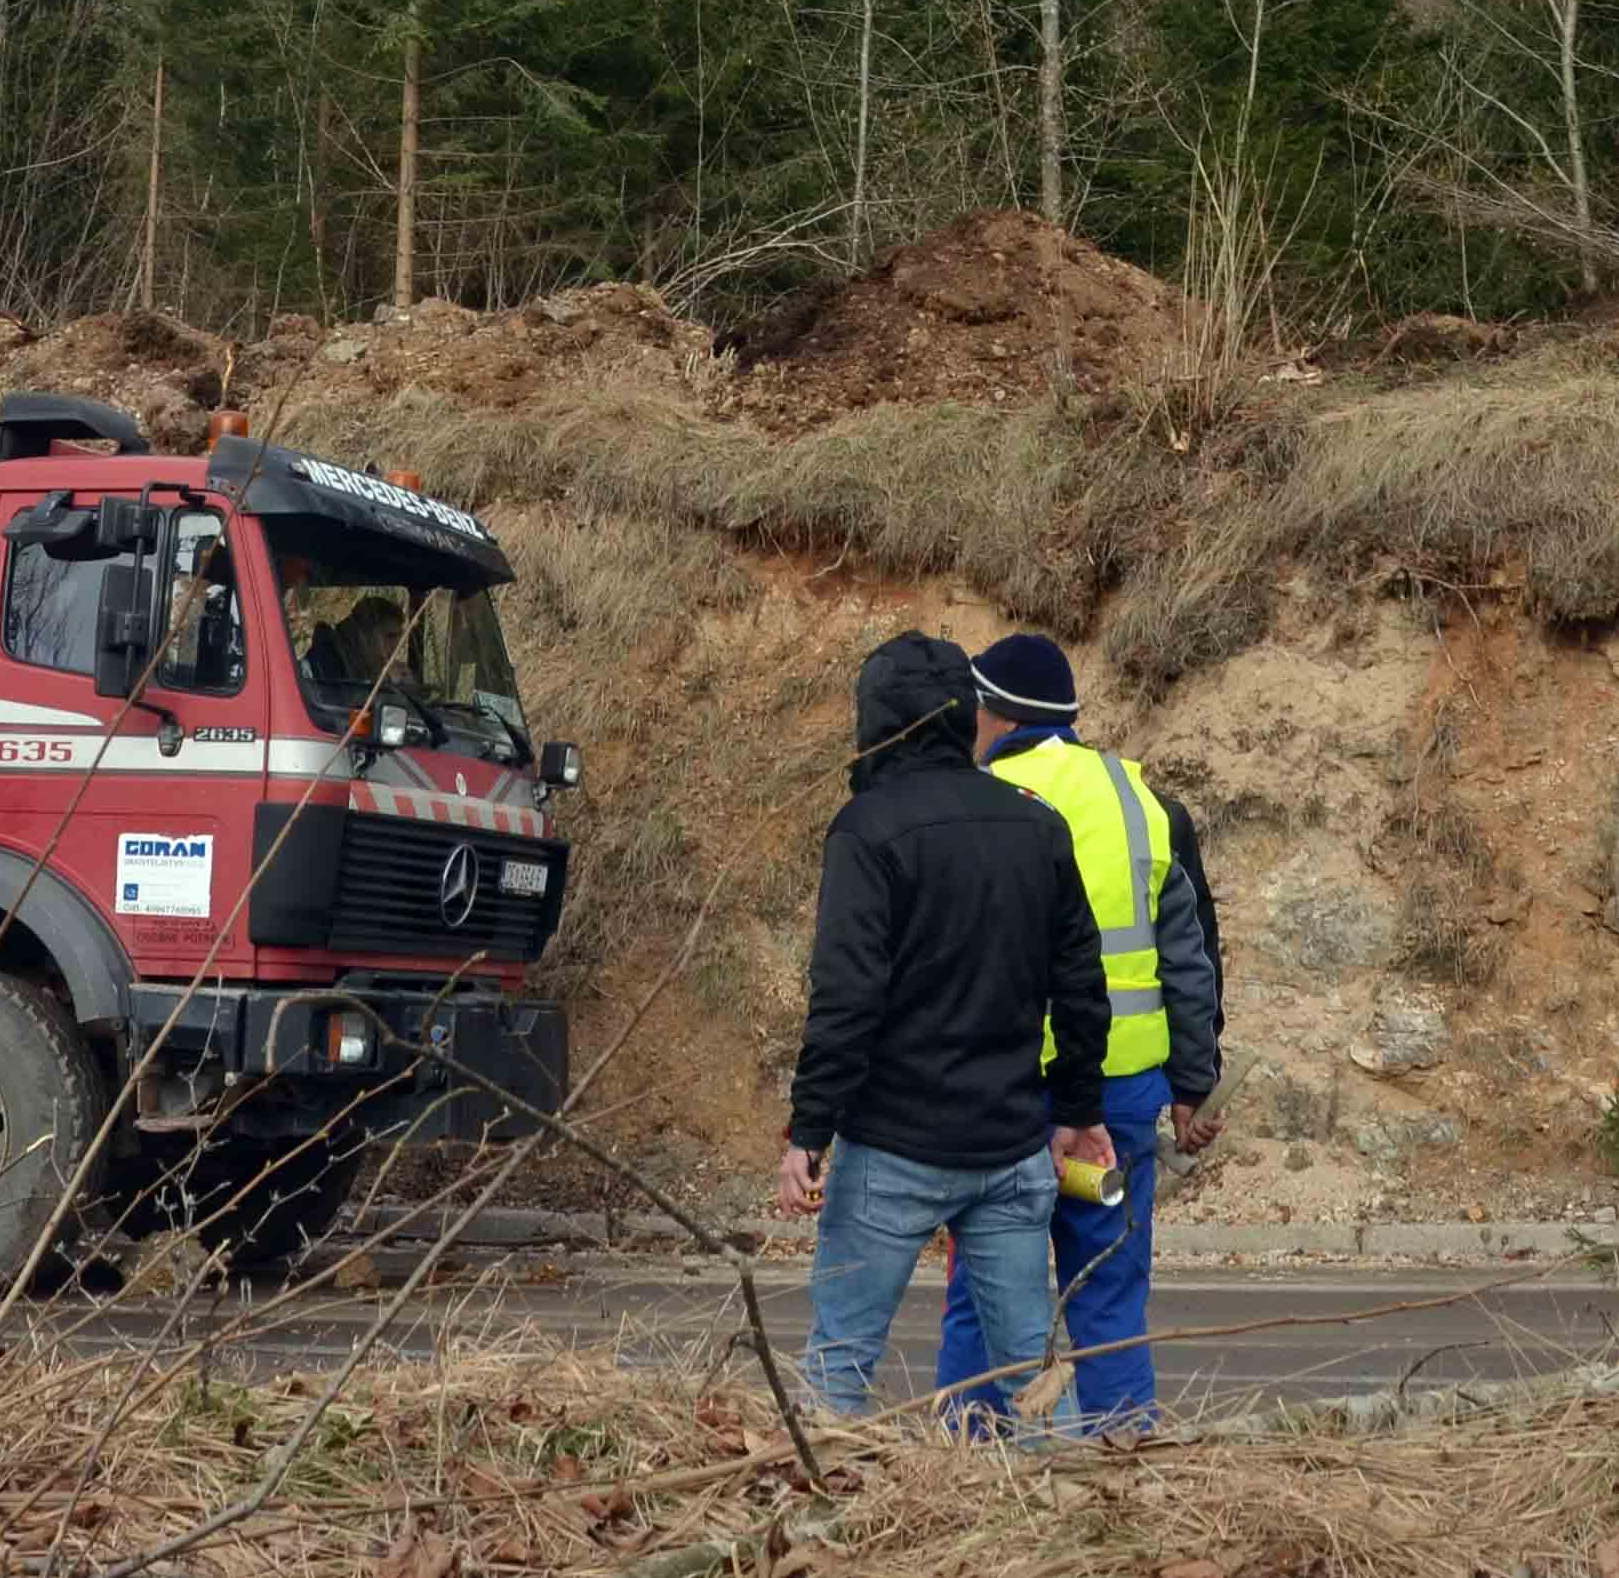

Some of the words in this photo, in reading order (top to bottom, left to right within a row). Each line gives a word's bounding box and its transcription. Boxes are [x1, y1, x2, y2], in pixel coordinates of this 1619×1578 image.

[300, 458, 484, 539] MERCEDES-BENZ
[194, 727, 254, 742] 2635
[125, 840, 205, 858] GORAN
